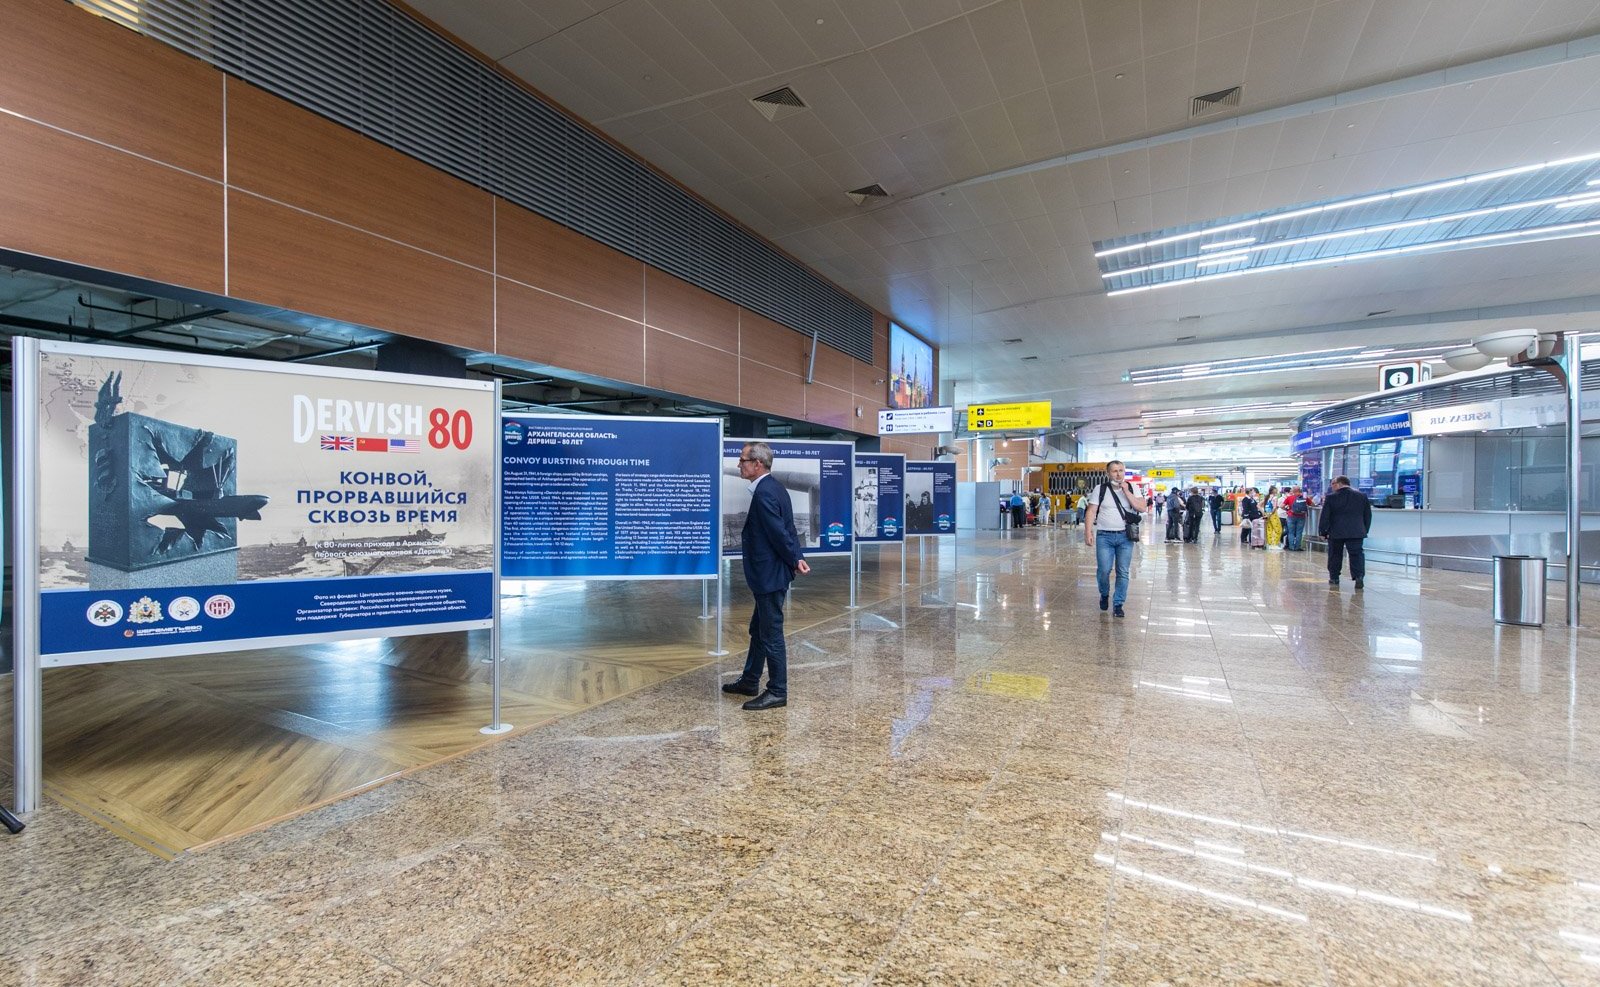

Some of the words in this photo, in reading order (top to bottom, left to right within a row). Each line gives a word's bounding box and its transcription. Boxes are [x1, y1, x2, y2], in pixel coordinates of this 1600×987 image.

[294, 394, 422, 443] DERVISH
[428, 408, 473, 450] 80
[1367, 421, 1410, 433] НАПРАВЛЕНИЯ
[340, 470, 432, 487] КОНВОЙ,
[298, 489, 467, 504] ПРОРВАВШИЙСЯ
[308, 510, 390, 523] СКВОЗЬ
[396, 510, 457, 522] ВРЕМЯ
